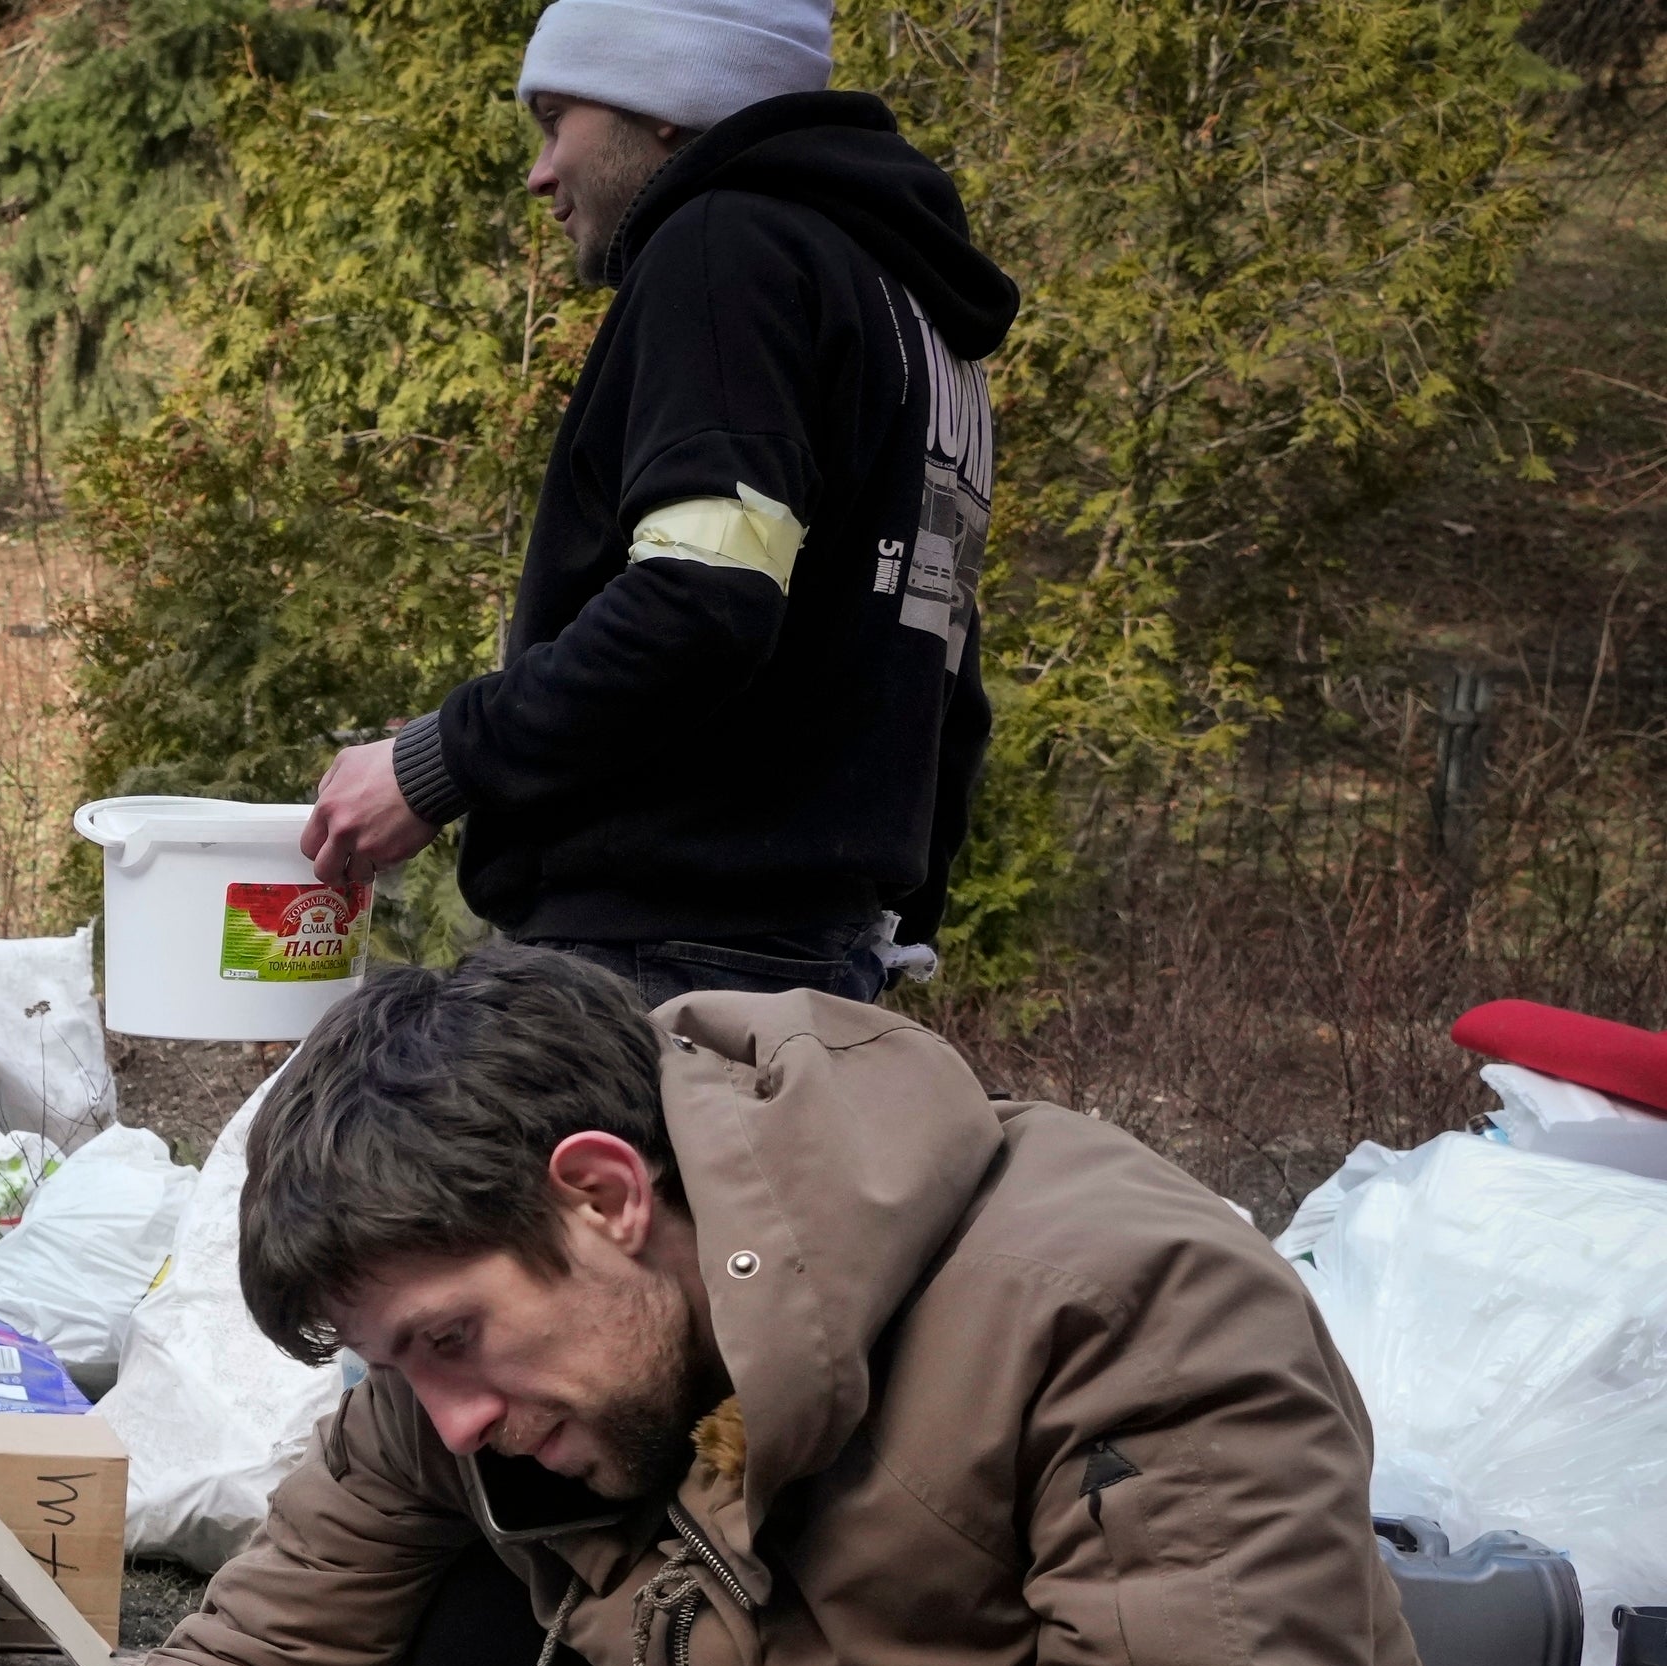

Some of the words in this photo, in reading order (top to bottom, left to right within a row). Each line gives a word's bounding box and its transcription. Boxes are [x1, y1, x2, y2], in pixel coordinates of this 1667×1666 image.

[878, 539, 905, 558] 5
[301, 923, 333, 934] СМАК
[283, 939, 343, 957] ПАСТА
